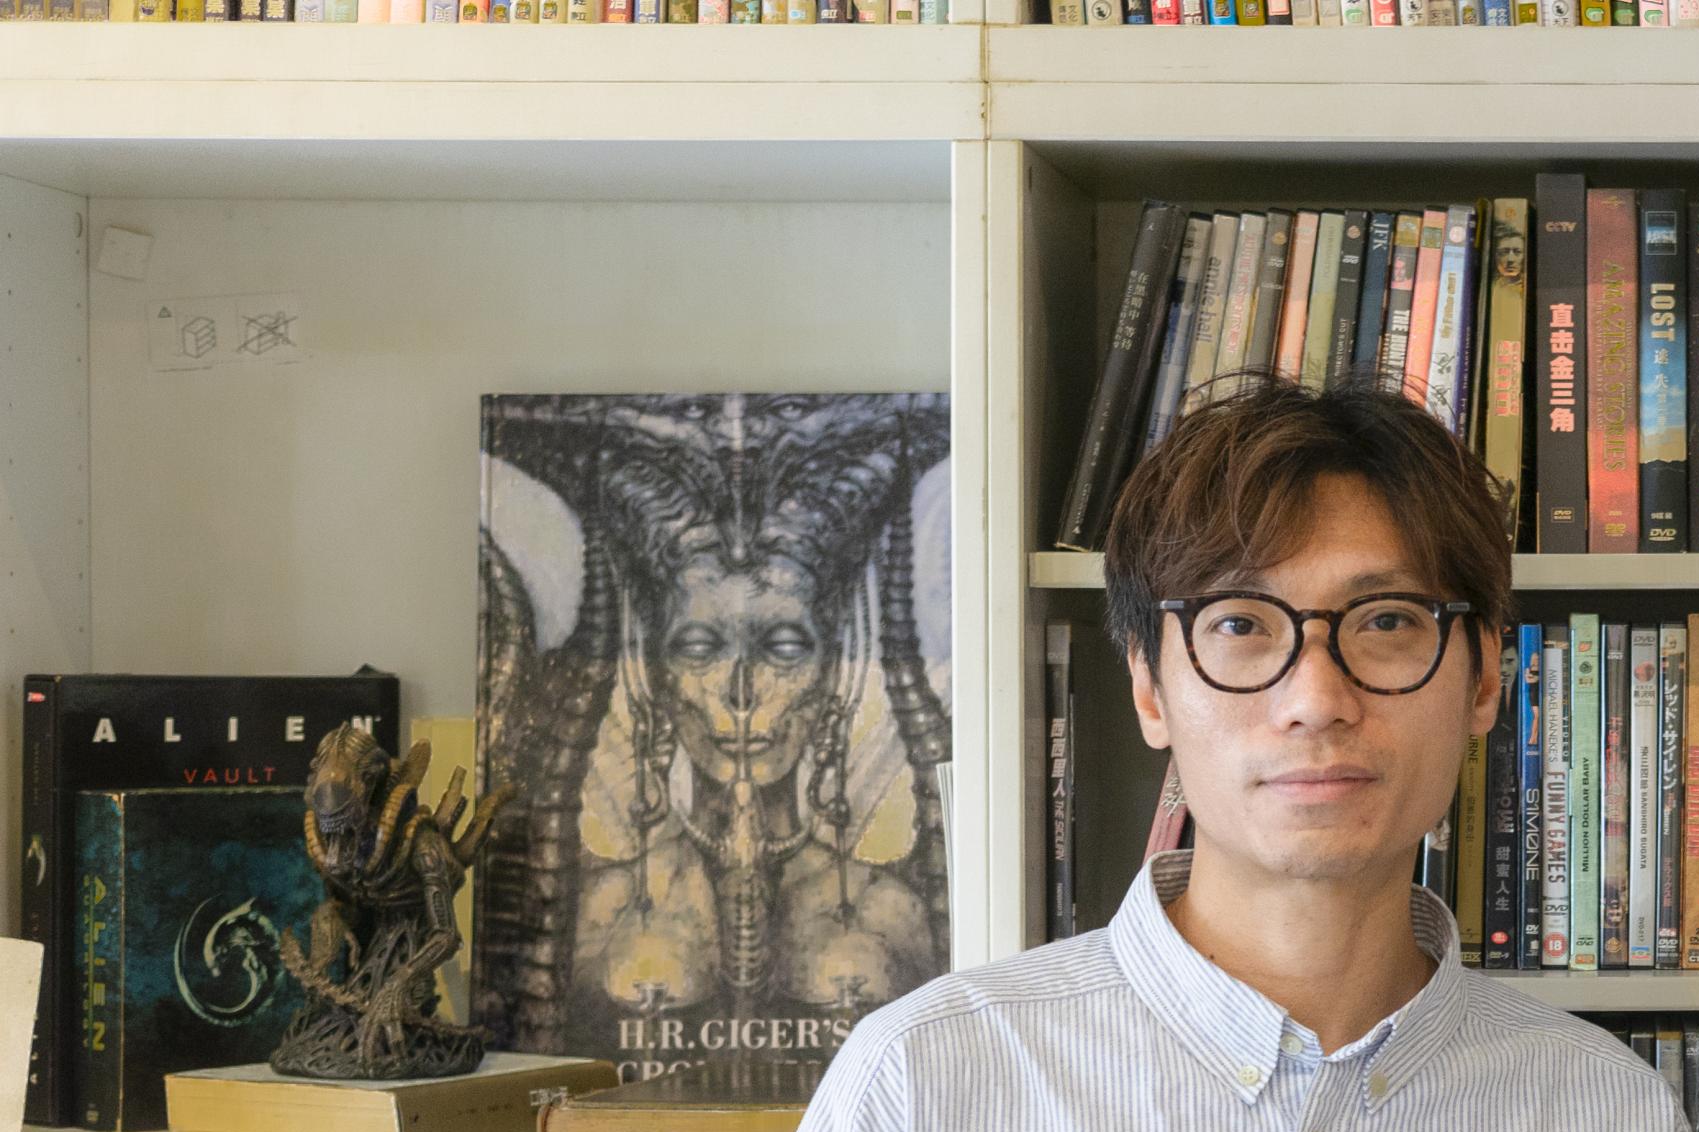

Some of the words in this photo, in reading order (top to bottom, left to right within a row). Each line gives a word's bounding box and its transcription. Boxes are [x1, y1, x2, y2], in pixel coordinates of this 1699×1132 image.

[1372, 218, 1390, 250] JFK
[1545, 221, 1577, 233] CCTV
[1201, 255, 1222, 306] annie
[1196, 306, 1216, 343] hall
[1393, 309, 1411, 333] THE
[1601, 259, 1626, 376] AMAZING
[1651, 283, 1676, 342] LOST
[1549, 302, 1576, 433] 直击金三角
[1602, 382, 1626, 471] STORIES
[1548, 669, 1558, 713] MICHAEL
[92, 716, 379, 742] ALIEN
[1548, 713, 1559, 763] HANEKE'S
[184, 767, 277, 784] VAULT
[1582, 757, 1590, 786] BABY
[1055, 800, 1065, 816] THE
[1546, 771, 1566, 825] FUNNY
[1582, 788, 1590, 829] DOLLAR
[1055, 818, 1066, 861] SICILIAN
[1547, 829, 1567, 884] GAMES
[1582, 831, 1590, 872] MILLION
[91, 876, 106, 1052] ALIEN
[1548, 940, 1563, 951] 18
